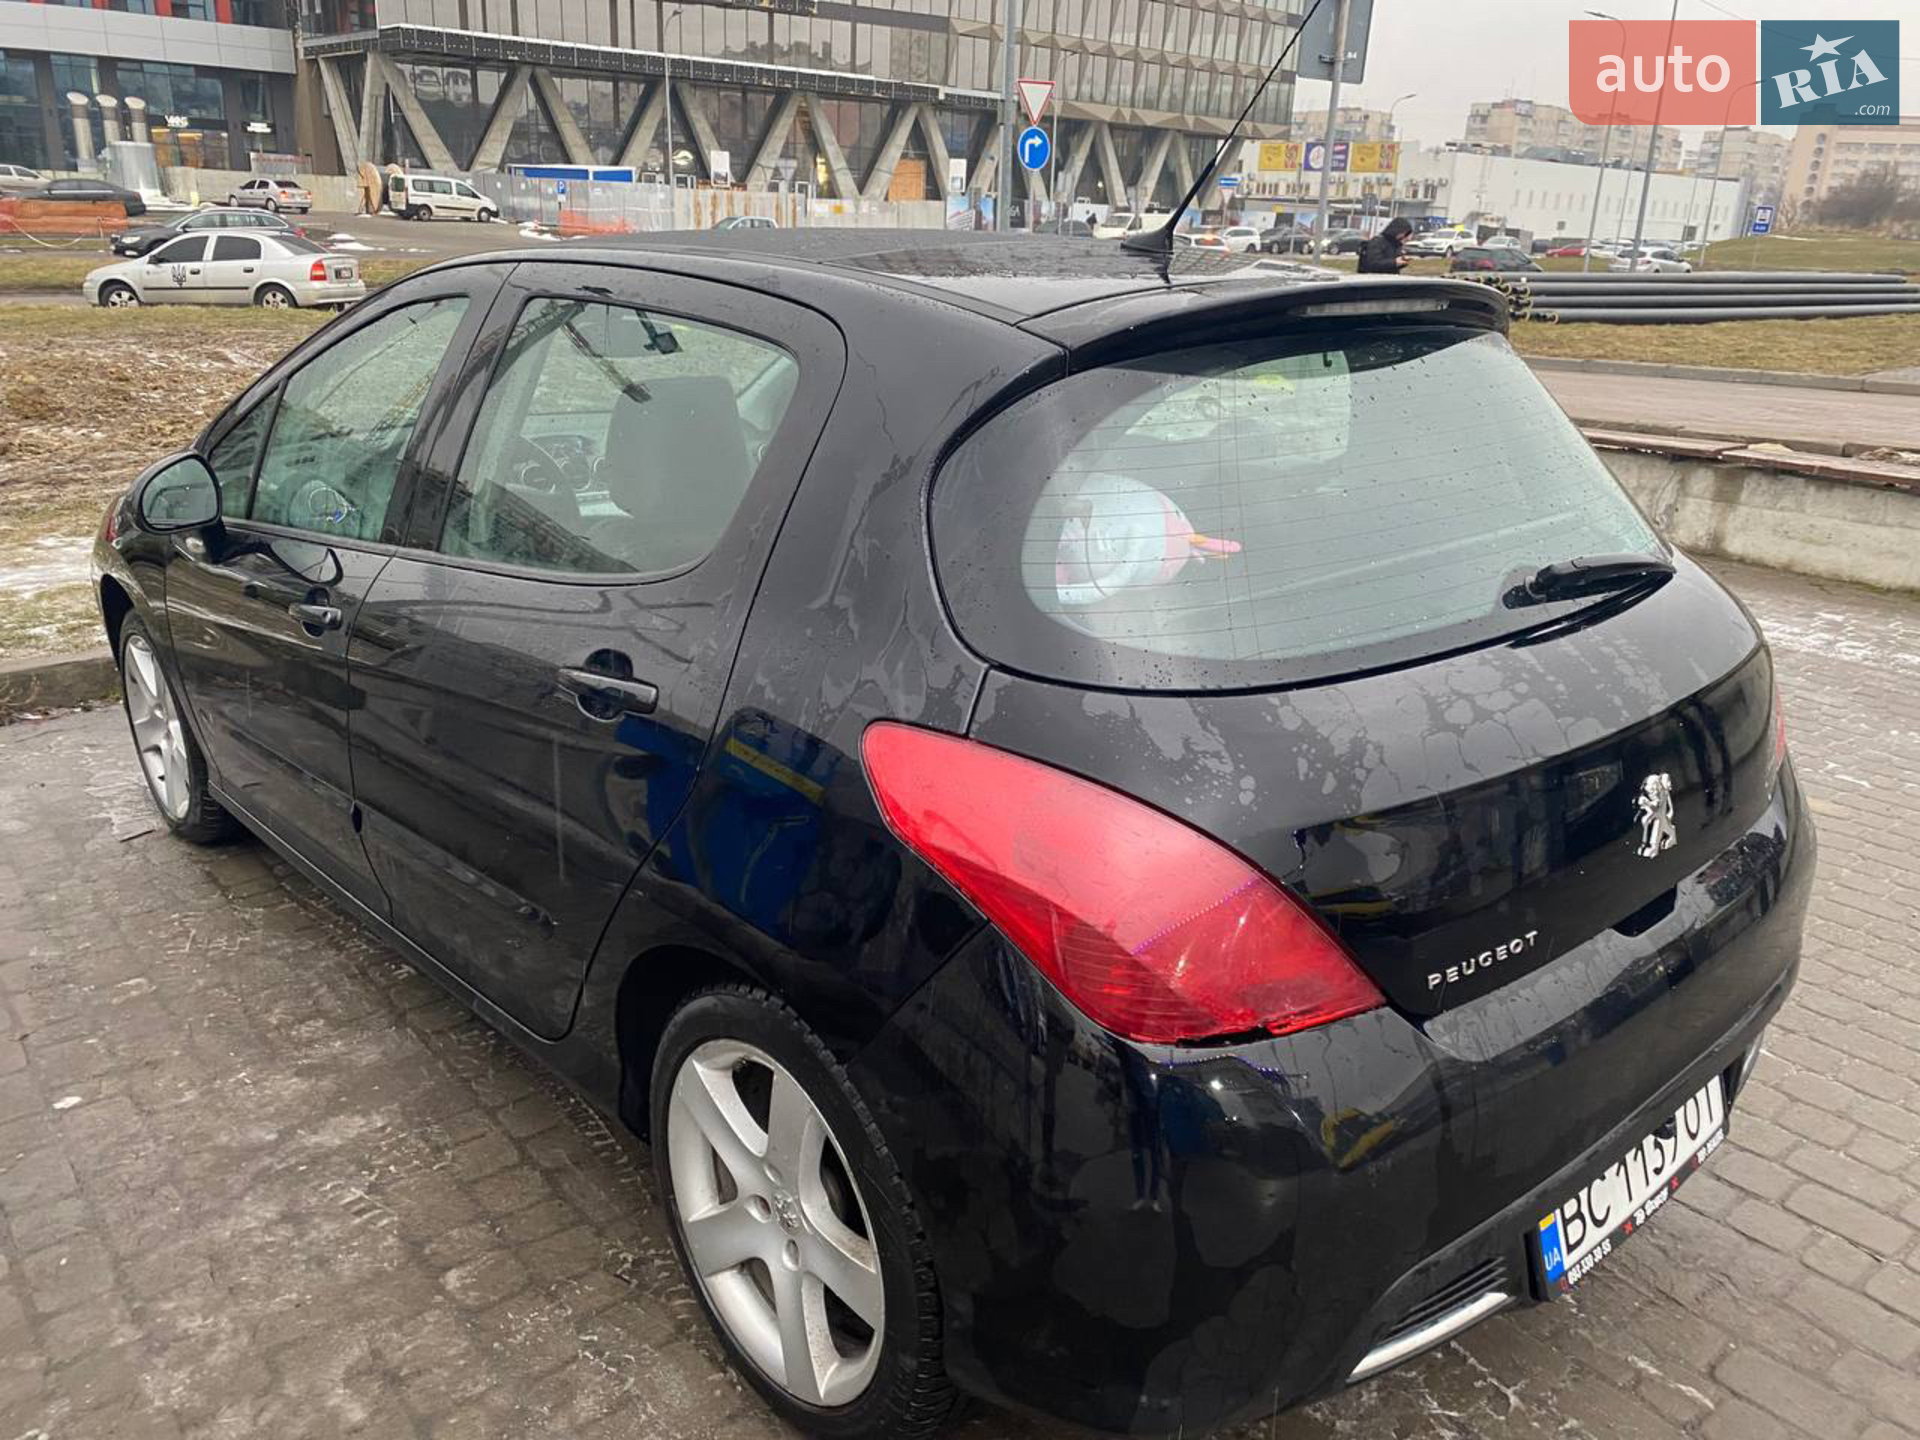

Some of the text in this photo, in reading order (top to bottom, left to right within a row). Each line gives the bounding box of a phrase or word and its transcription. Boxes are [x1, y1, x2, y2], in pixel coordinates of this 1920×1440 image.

[1427, 930, 1538, 990] PEUGEOT
[1560, 1177, 1611, 1258] BC
[1544, 1246, 1561, 1271] UA
